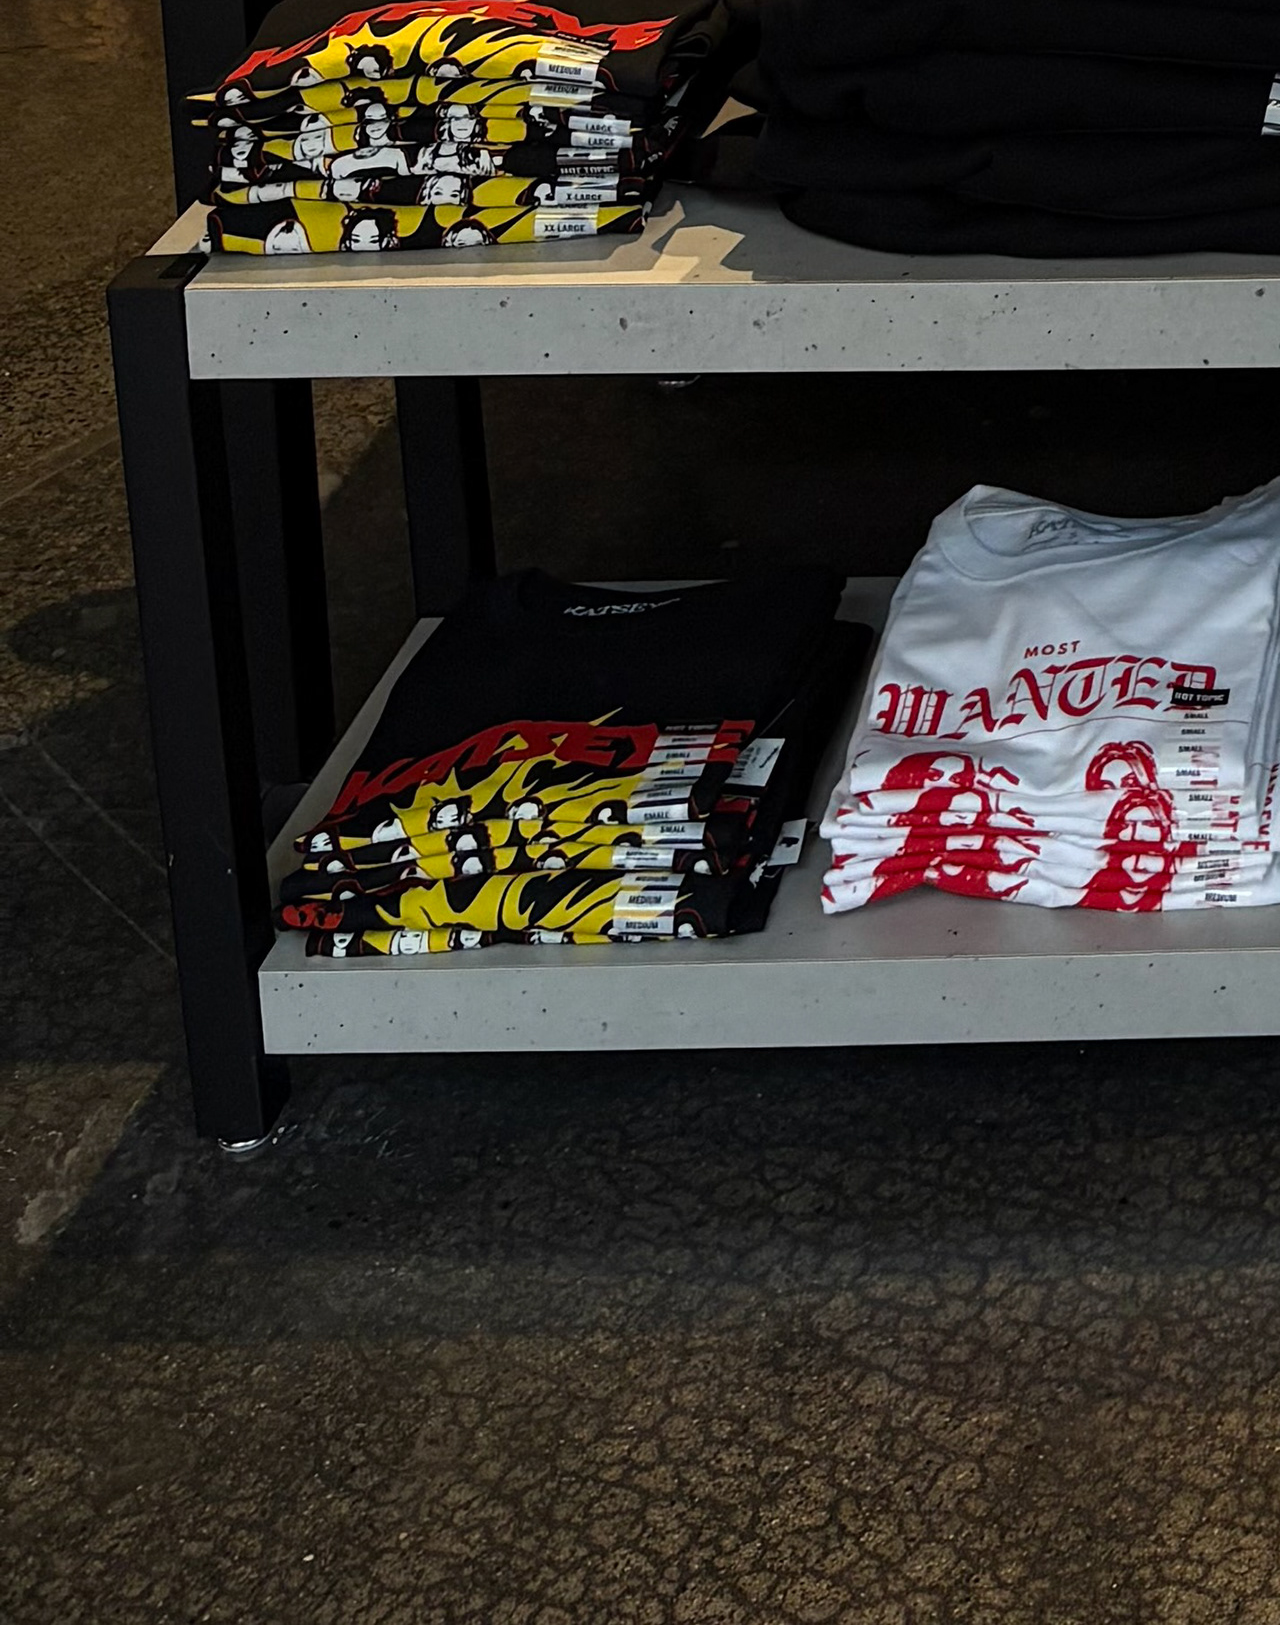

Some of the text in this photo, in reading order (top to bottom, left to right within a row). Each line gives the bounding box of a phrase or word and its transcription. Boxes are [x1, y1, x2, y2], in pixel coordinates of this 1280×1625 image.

[549, 64, 582, 75] MEDIUM
[545, 85, 579, 94] MEDIUM
[585, 123, 612, 132] LARGE
[588, 138, 615, 146] LARGE
[1023, 640, 1081, 659] MOST
[875, 654, 1216, 740] WANTED
[644, 812, 670, 822] SMALL
[629, 895, 662, 905] MEDIUM
[626, 921, 659, 929] MEDIUM
